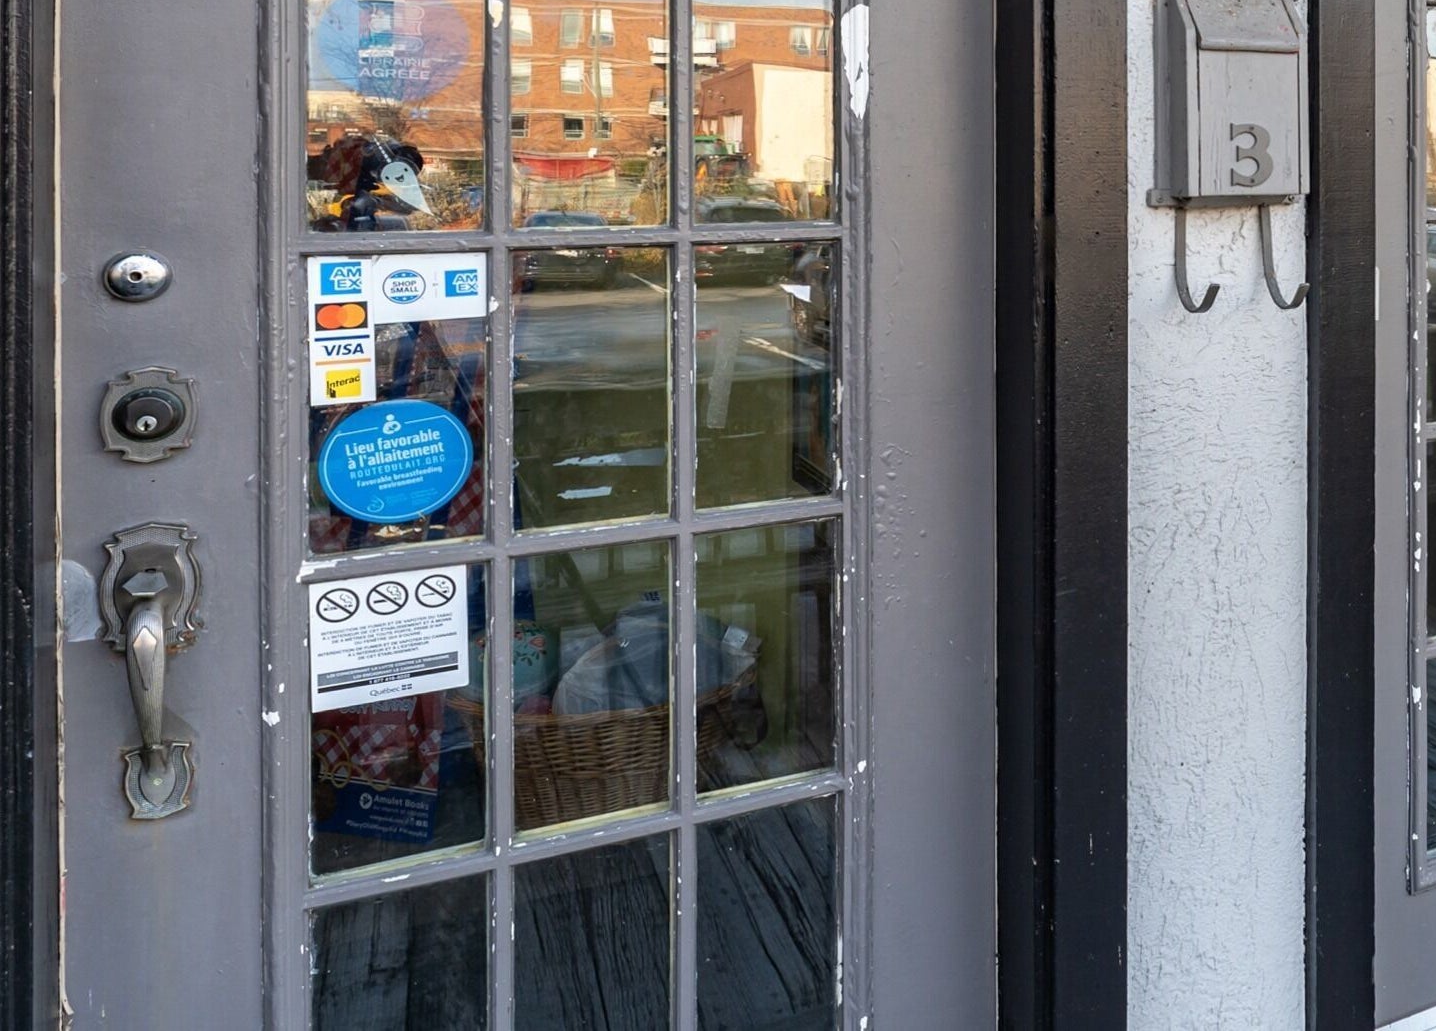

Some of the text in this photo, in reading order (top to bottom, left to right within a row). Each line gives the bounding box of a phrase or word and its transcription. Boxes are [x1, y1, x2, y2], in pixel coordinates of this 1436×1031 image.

[1230, 123, 1274, 187] 3
[333, 267, 361, 278] AM
[390, 286, 419, 294] SMALL
[392, 280, 417, 288] SHOP
[324, 343, 364, 356] VISA
[326, 374, 361, 391] Interac
[345, 428, 441, 457] Lieu favorable
[347, 442, 445, 470] à l'allaitement
[350, 454, 446, 480] ROUTEDULAIT.ORG
[370, 686, 400, 697] Québec
